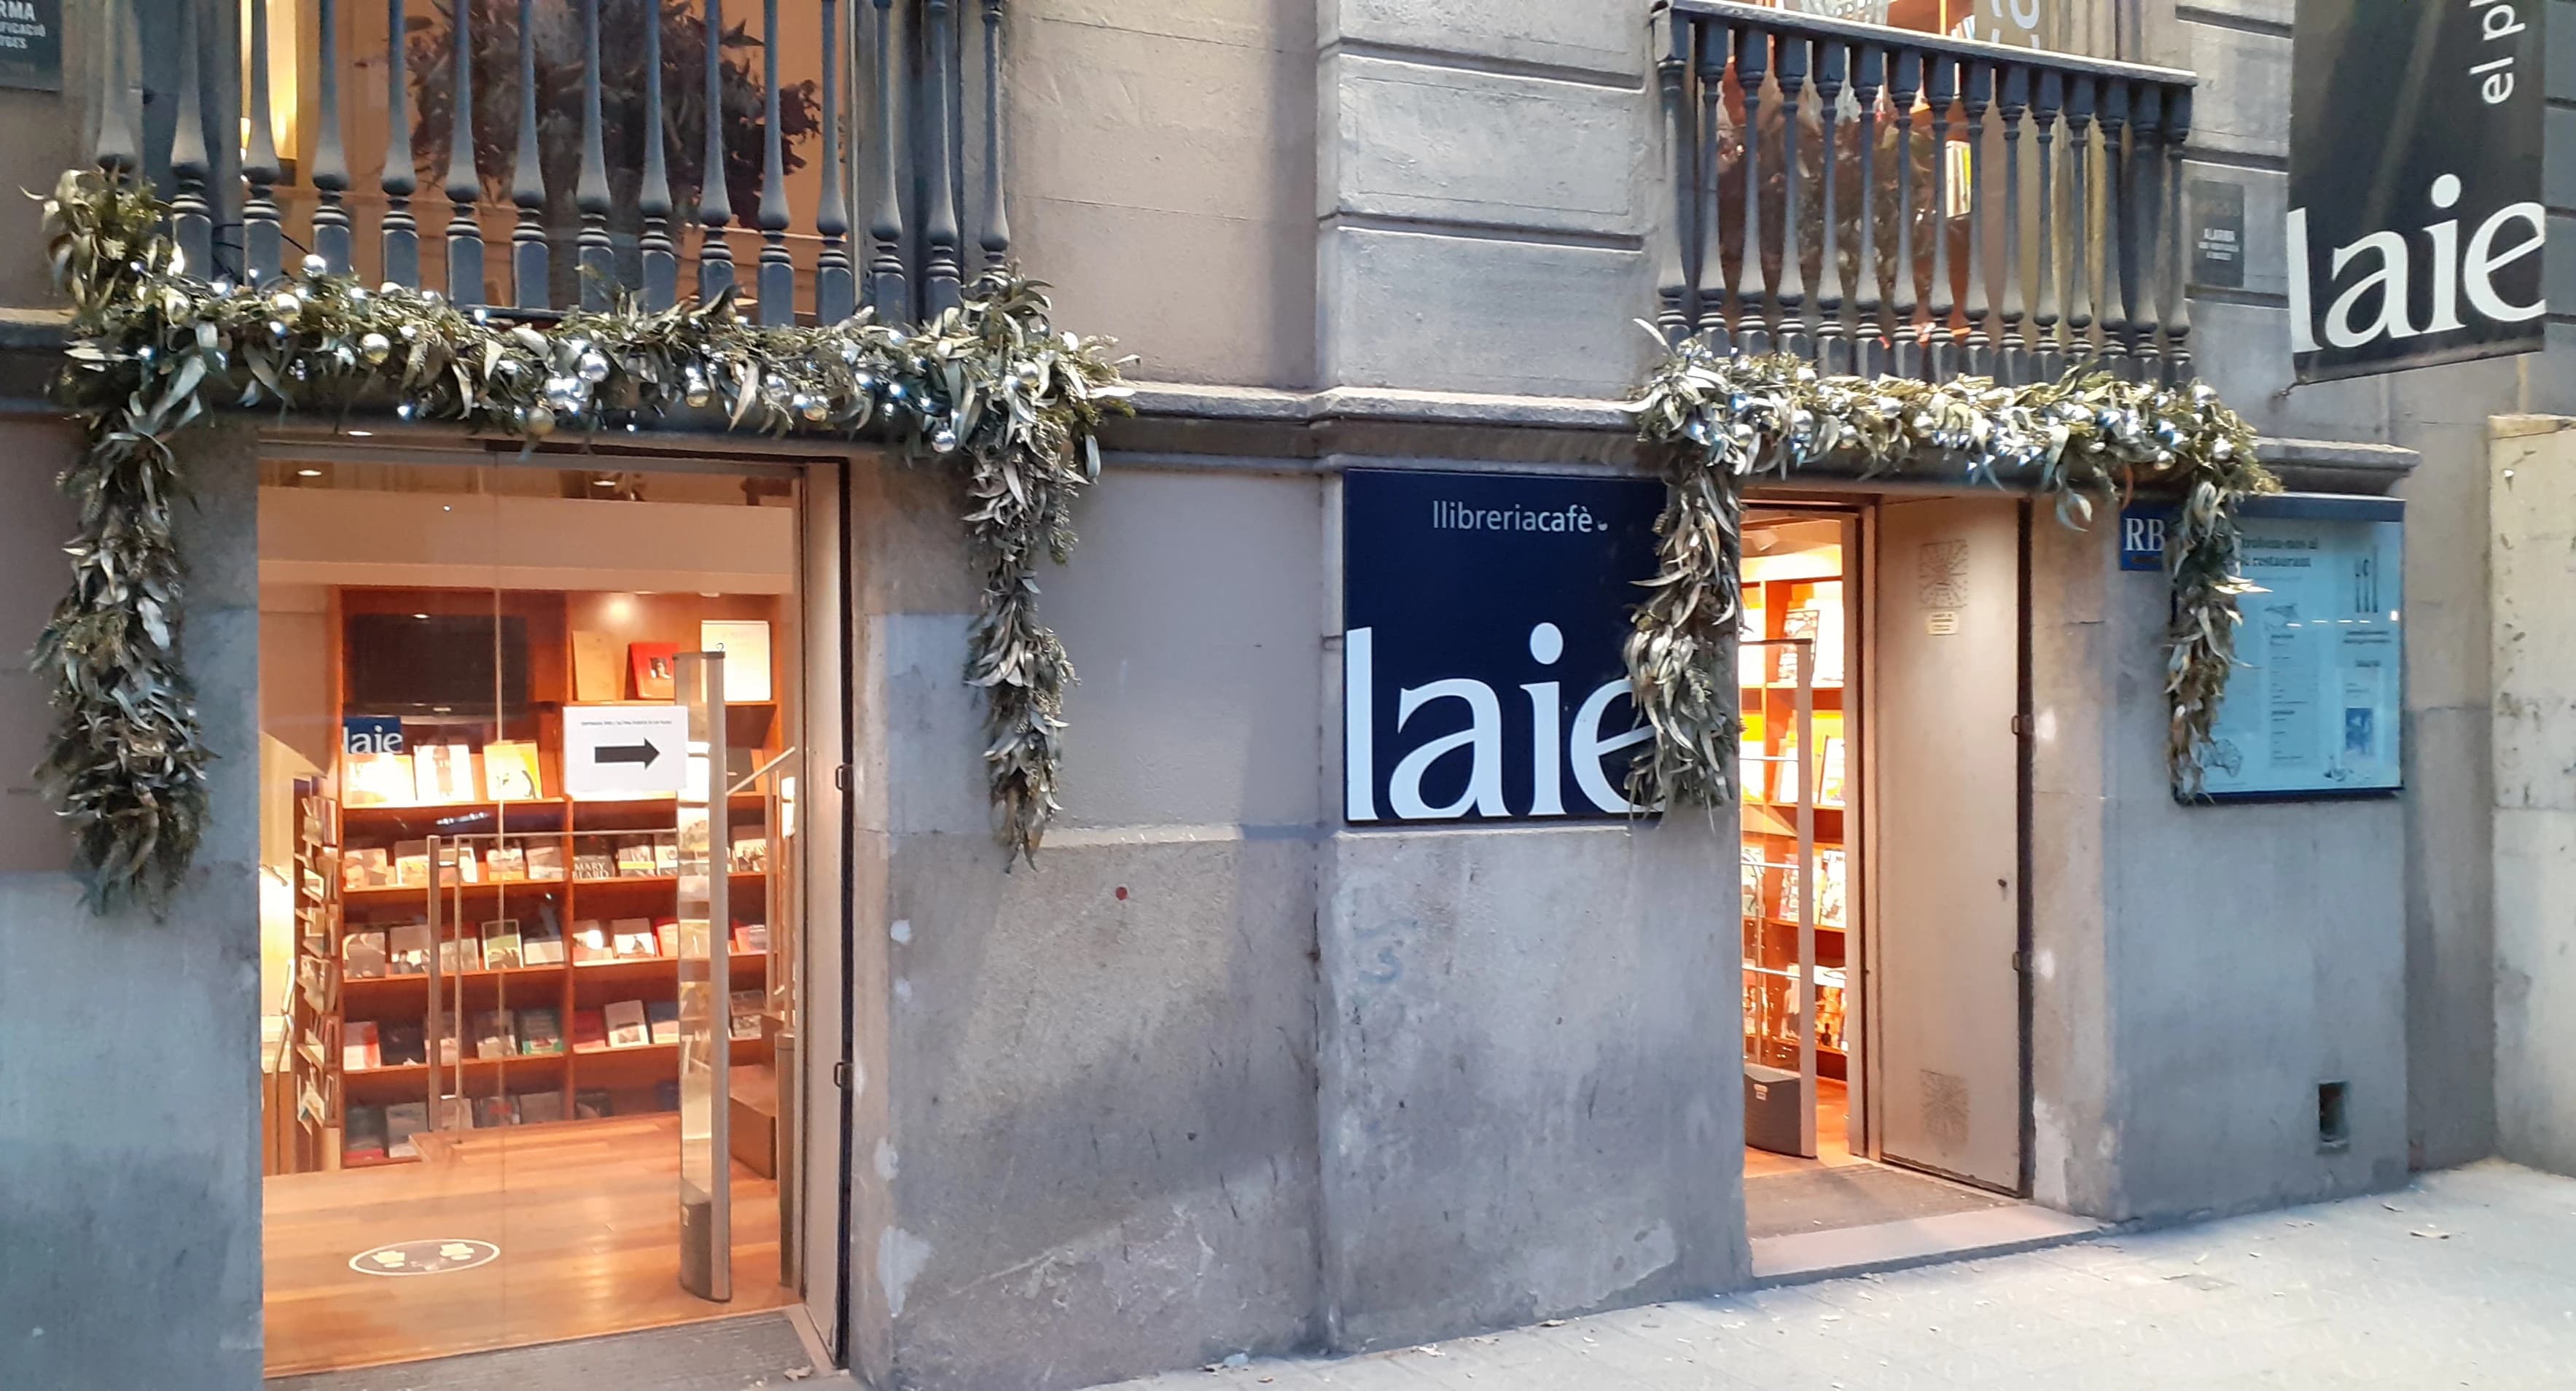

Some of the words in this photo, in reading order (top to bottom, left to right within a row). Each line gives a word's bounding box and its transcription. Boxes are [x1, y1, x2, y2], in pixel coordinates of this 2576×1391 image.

[0, 1, 36, 21] RMA
[2469, 57, 2514, 104] el
[2287, 173, 2546, 353] laie
[2125, 518, 2166, 551] RB
[343, 725, 403, 755] laie
[1346, 622, 1666, 821] laie
